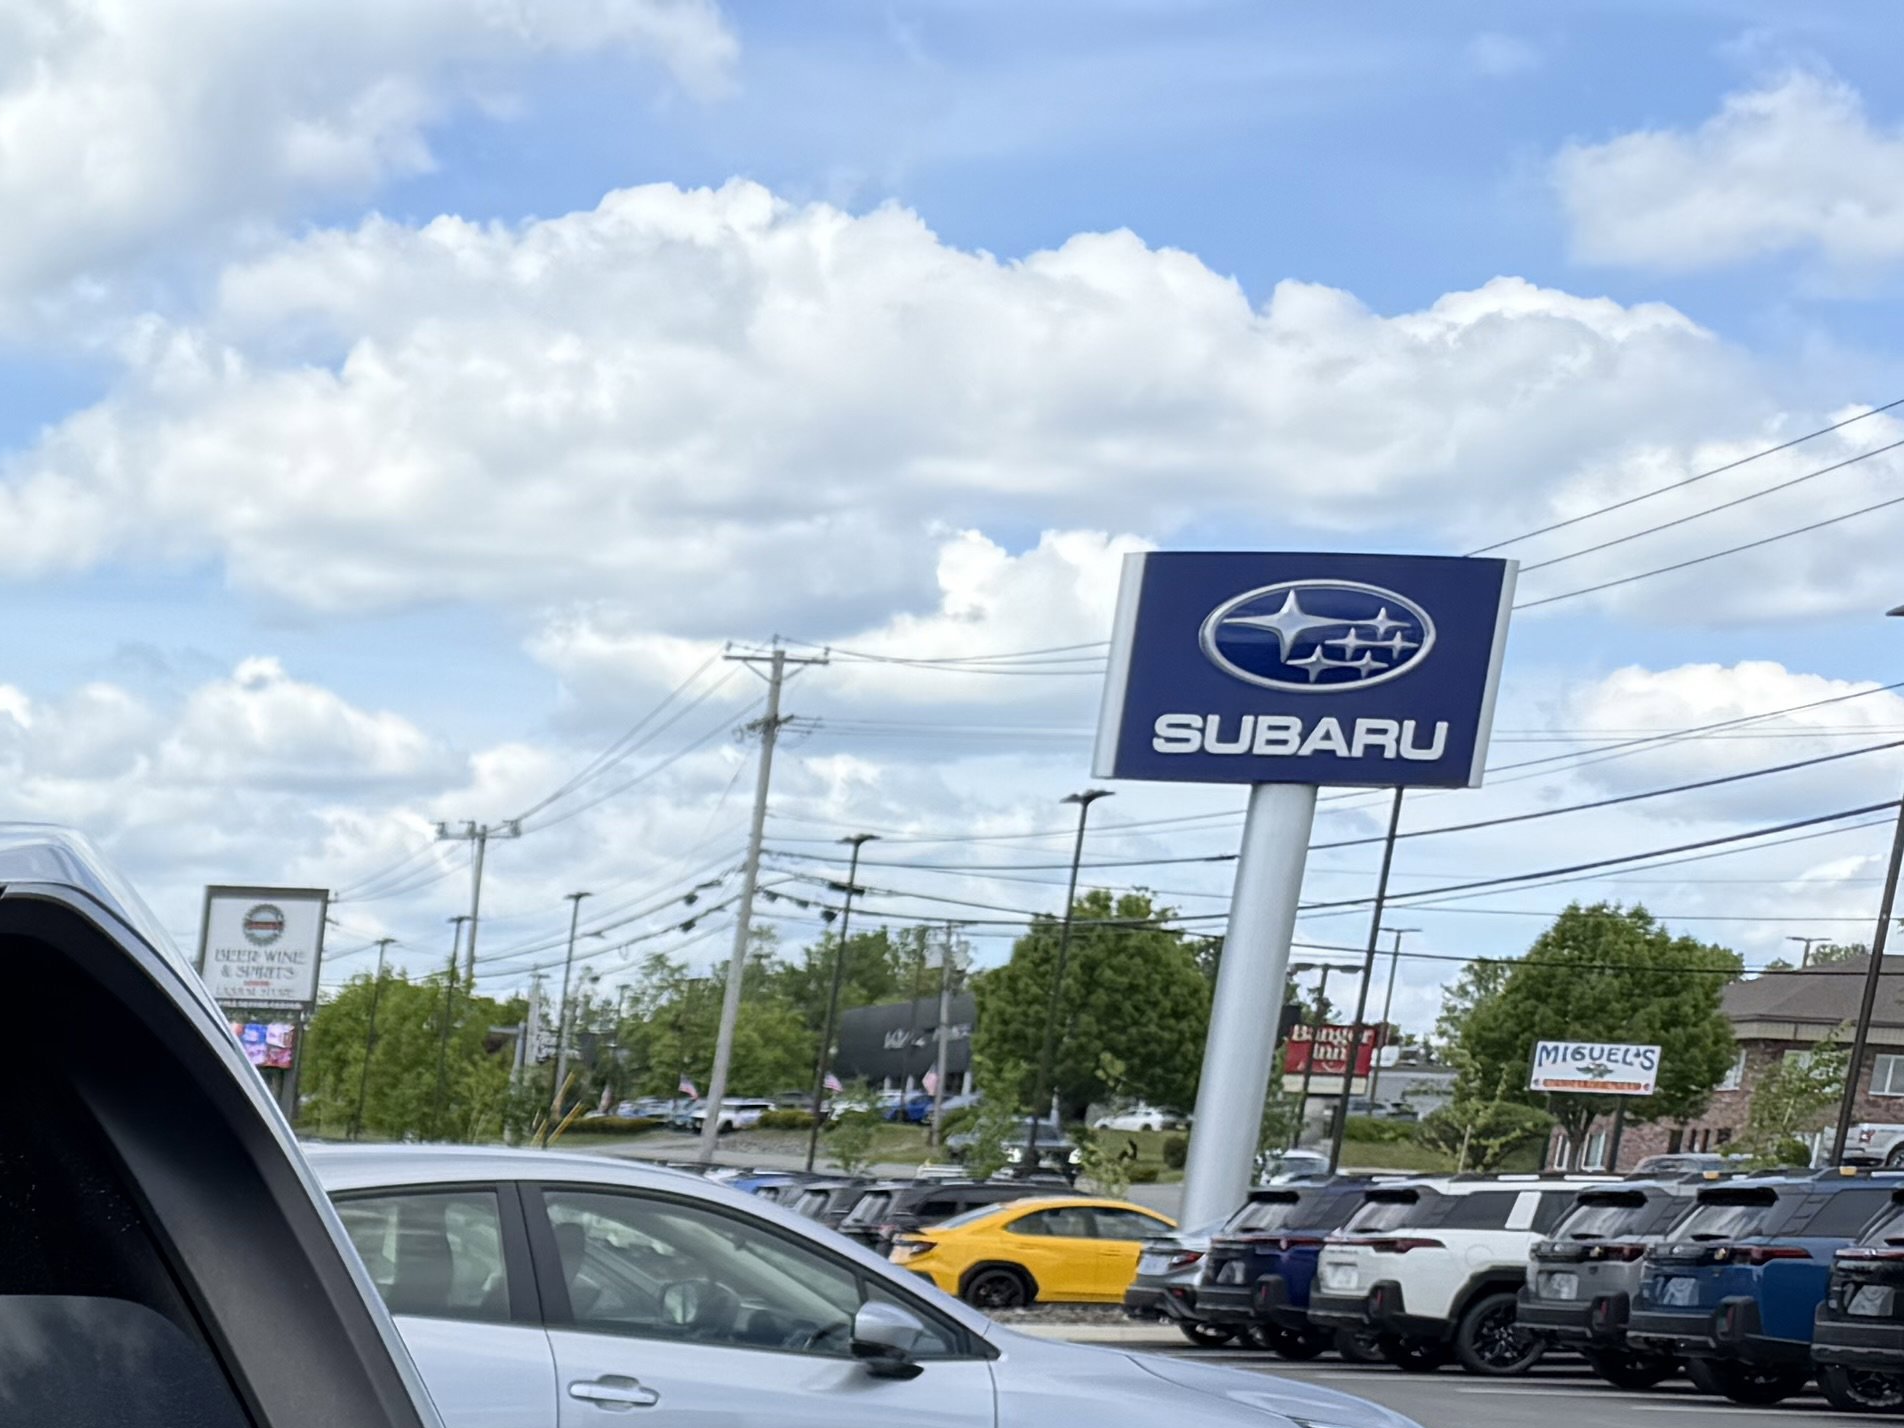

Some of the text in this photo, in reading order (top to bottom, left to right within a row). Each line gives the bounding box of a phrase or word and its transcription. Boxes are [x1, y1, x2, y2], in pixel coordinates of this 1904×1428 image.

[1152, 713, 1449, 761] SUBARU
[264, 950, 306, 965] WINE
[1538, 1044, 1656, 1070] MIGUEL'S
